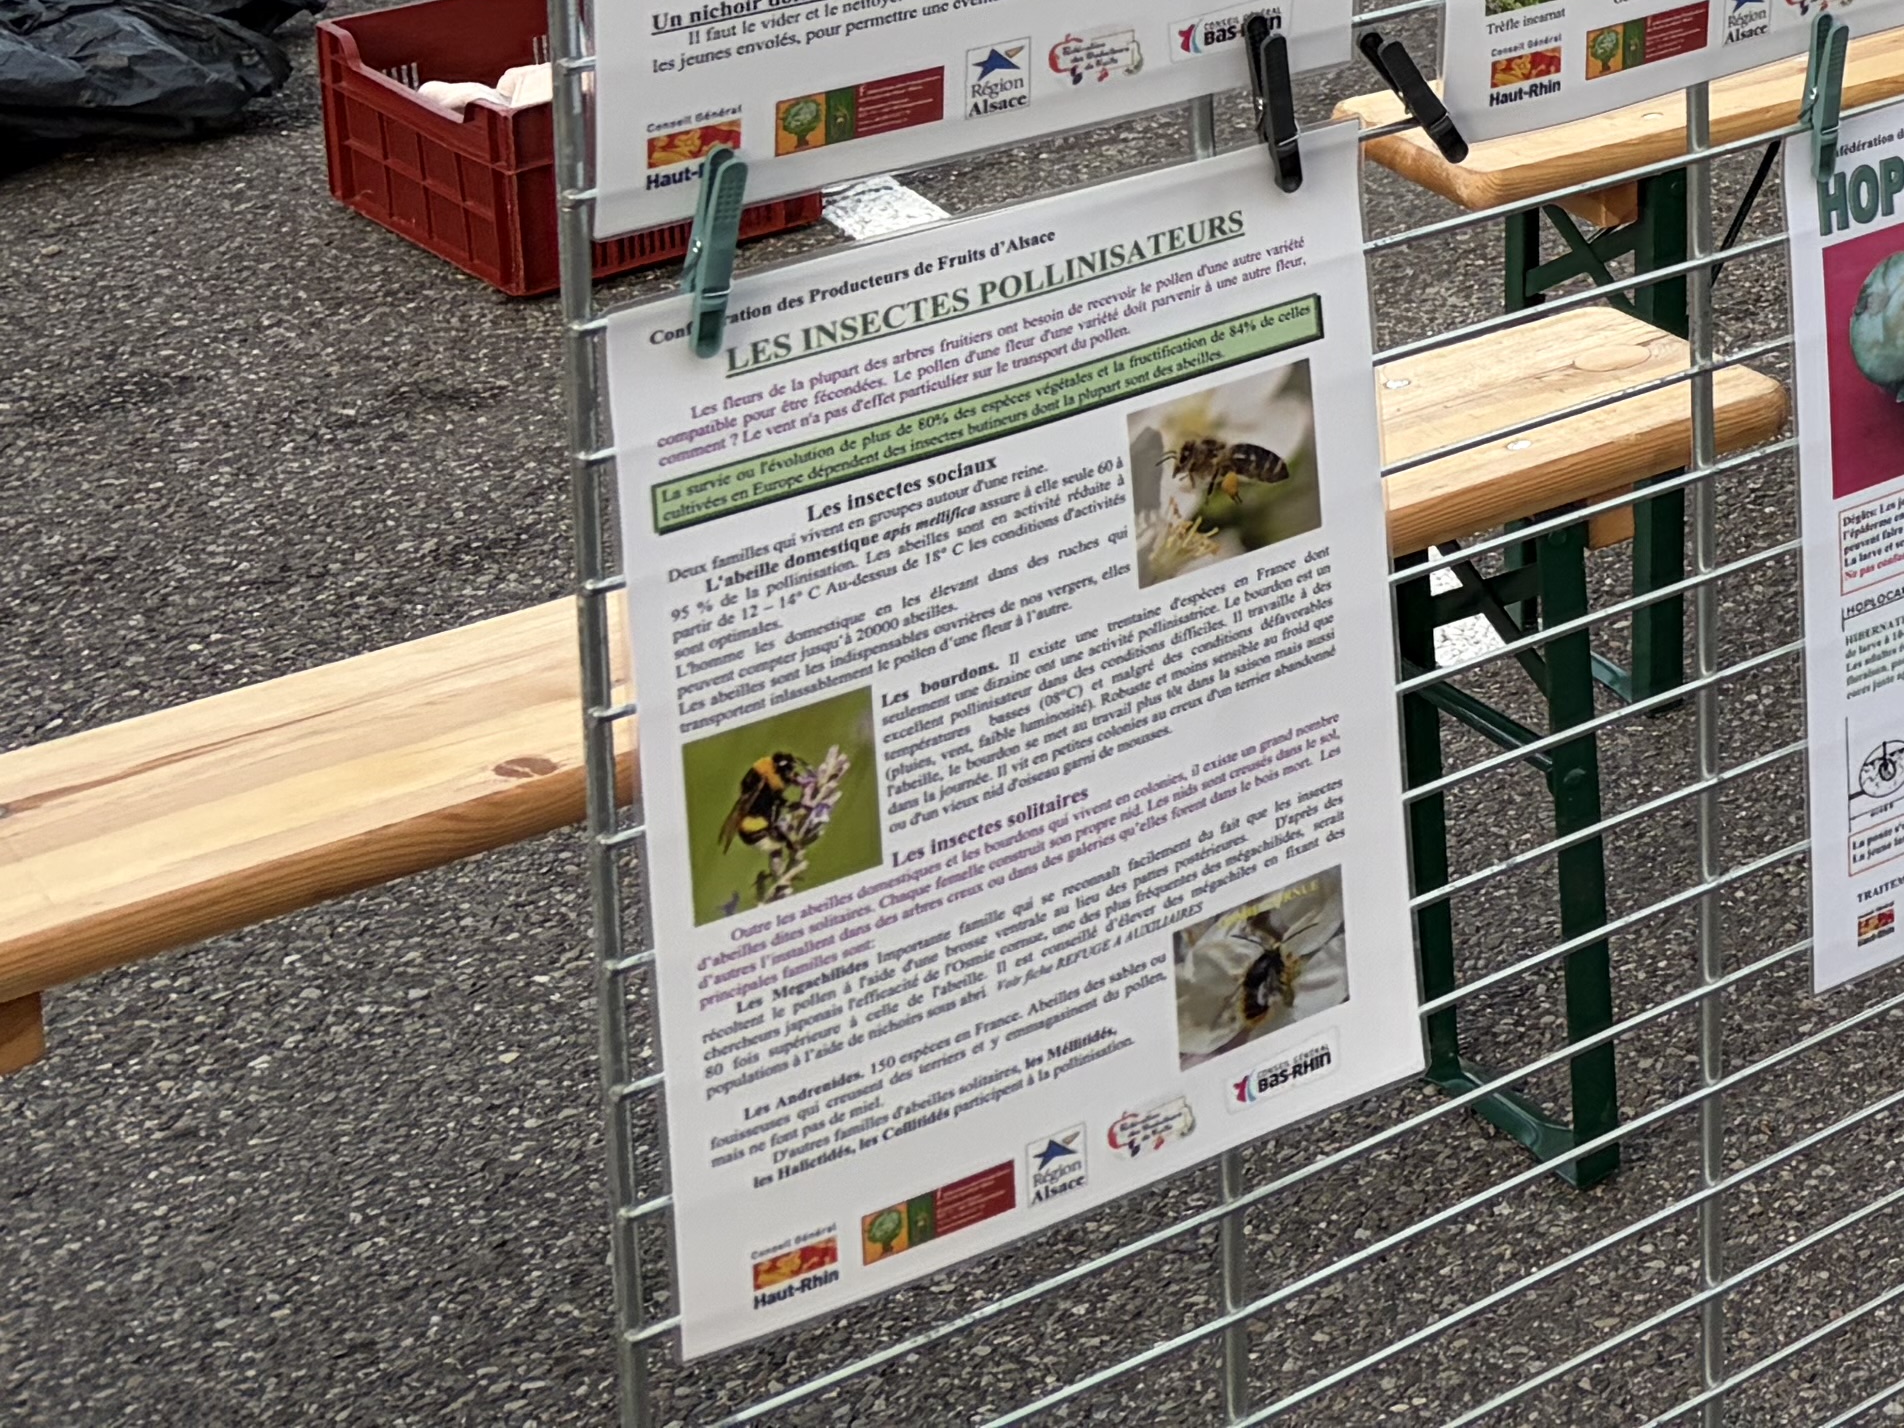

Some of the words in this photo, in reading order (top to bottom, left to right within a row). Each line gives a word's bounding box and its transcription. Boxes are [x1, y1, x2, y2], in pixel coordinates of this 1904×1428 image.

[1489, 79, 1561, 108] Haut-Rhin
[726, 330, 792, 373] LES
[801, 285, 969, 349] INSECTES
[978, 209, 1246, 308] POLLINISATEURS
[1034, 1160, 1082, 1185] Région
[1032, 1176, 1084, 1205] Alsace
